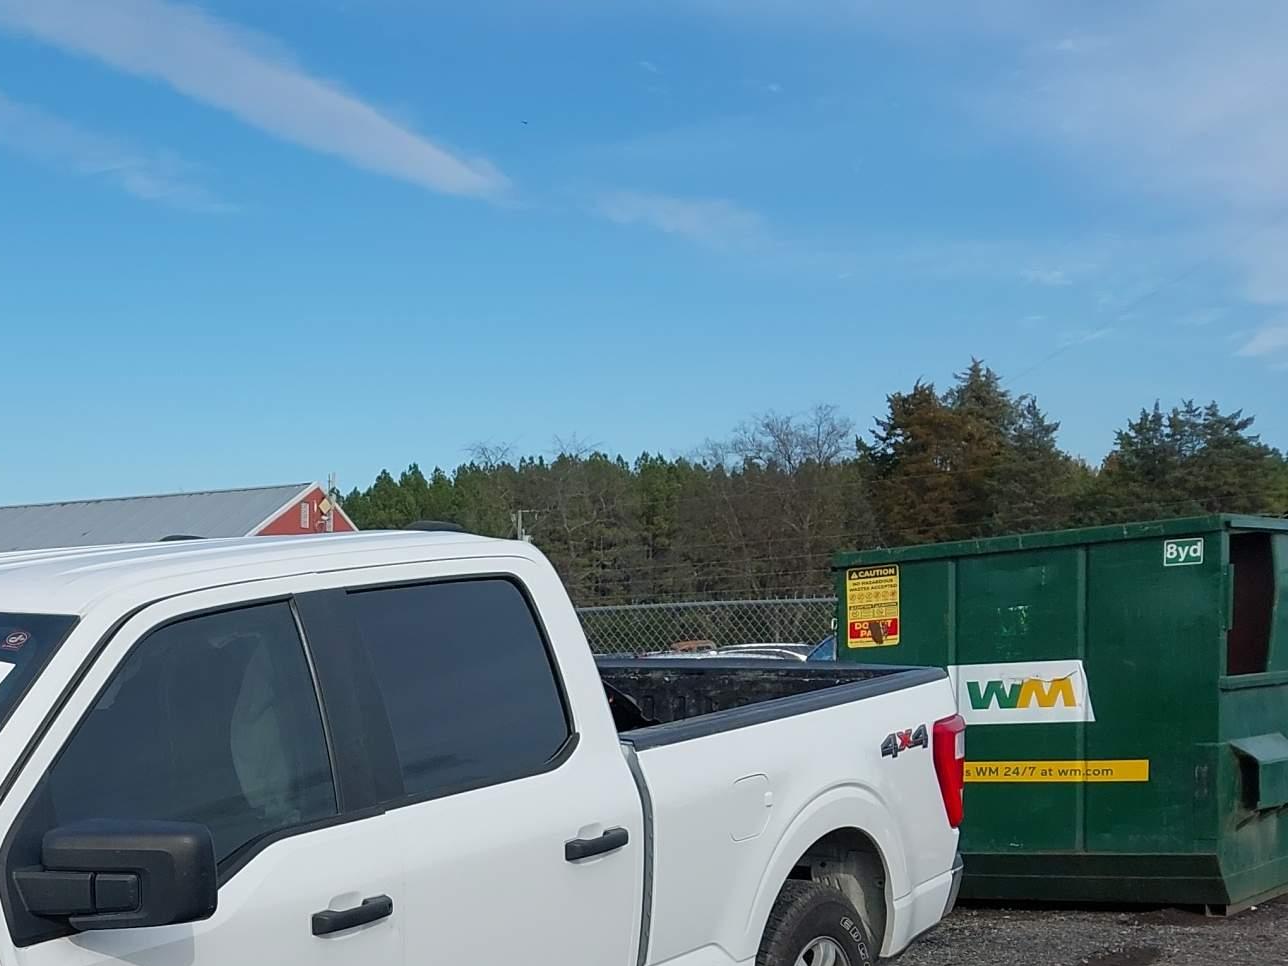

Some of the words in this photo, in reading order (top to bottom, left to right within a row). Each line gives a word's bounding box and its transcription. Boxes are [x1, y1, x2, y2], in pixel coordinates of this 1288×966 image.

[1166, 541, 1201, 562] 8yd
[858, 567, 895, 577] CAUTION
[966, 677, 1077, 711] WM
[975, 767, 999, 777] WM
[1003, 766, 1037, 777] 24/7
[1040, 767, 1053, 777] at
[1057, 767, 1114, 777] wm.com
